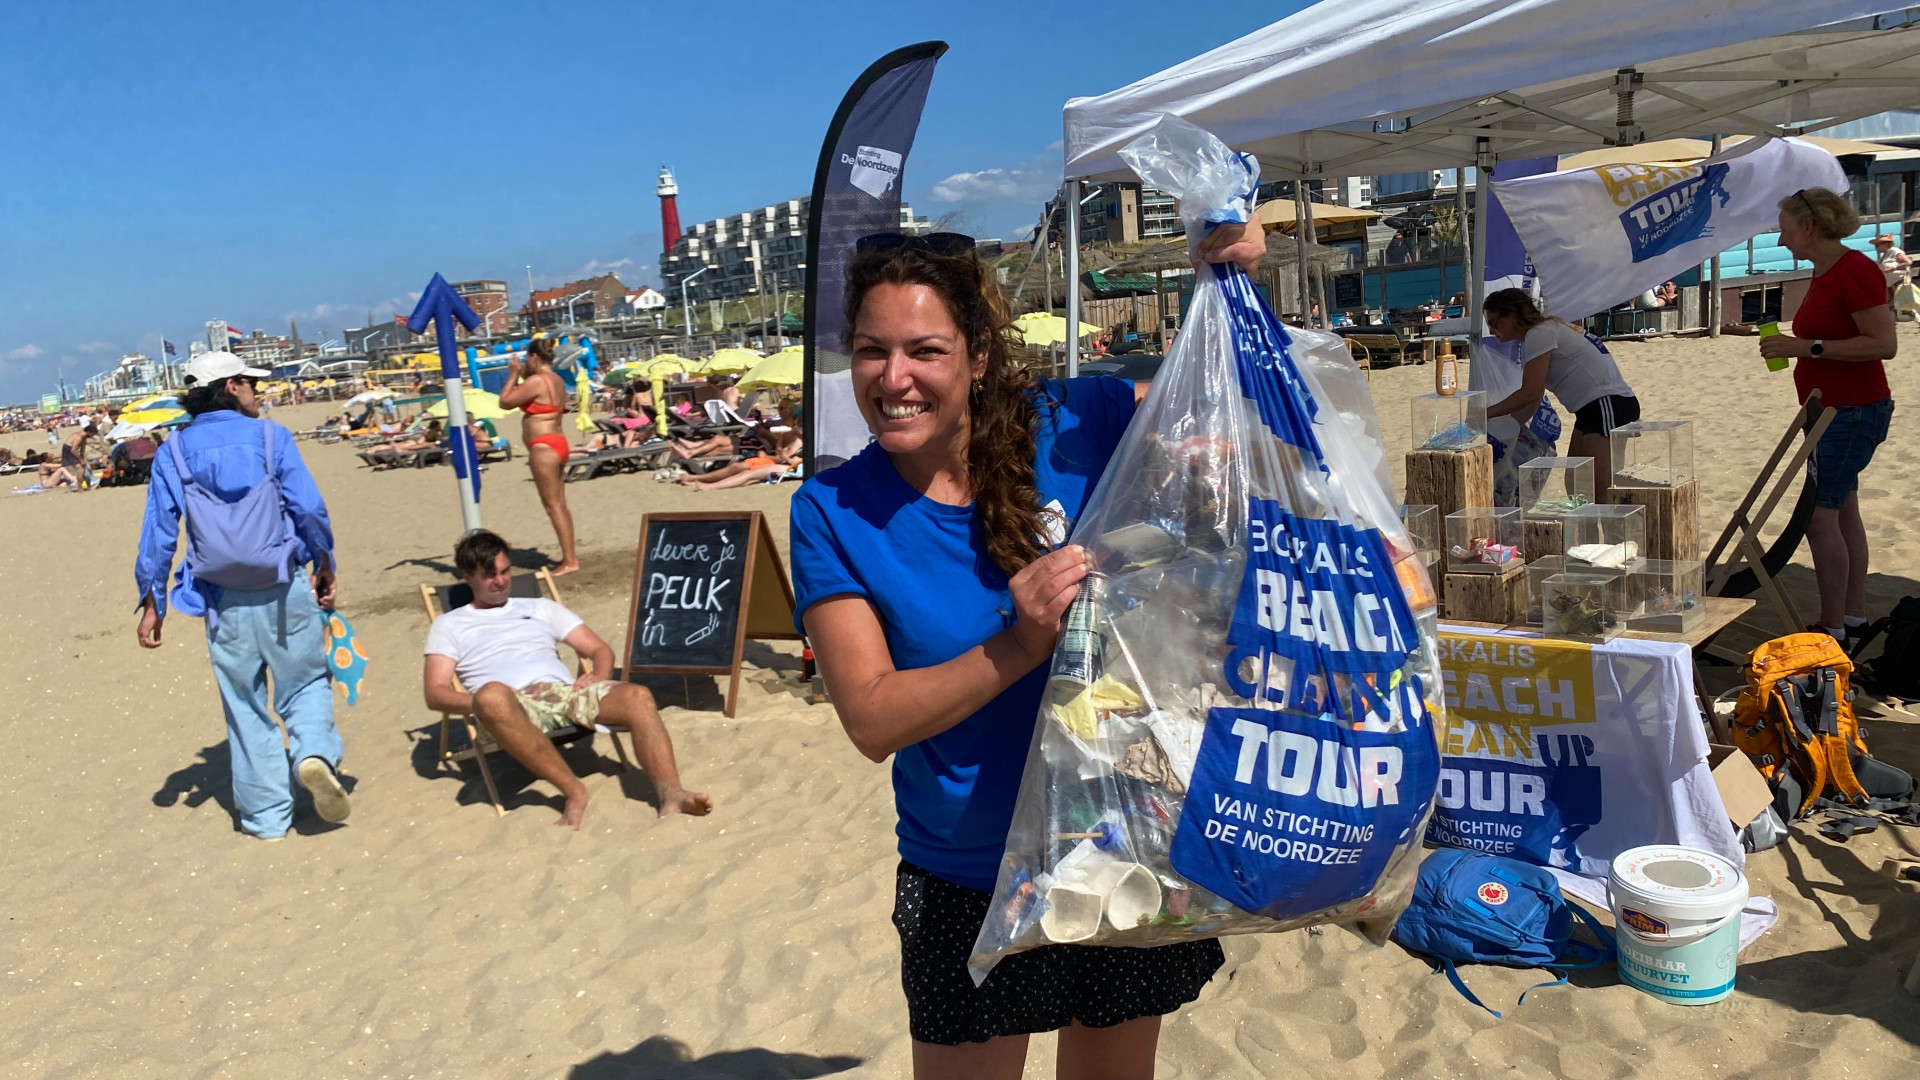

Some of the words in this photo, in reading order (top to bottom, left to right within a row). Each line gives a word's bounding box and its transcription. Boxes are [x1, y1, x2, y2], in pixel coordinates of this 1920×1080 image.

[841, 153, 855, 165] De
[855, 157, 898, 175] Noordzee
[1541, 409, 1560, 428] TO
[710, 529, 736, 574] je
[645, 573, 731, 611] PEUK
[642, 608, 667, 646] in
[1438, 637, 1536, 668] SKALIS
[1442, 669, 1576, 720] EACH
[1442, 718, 1533, 760] EAN
[1537, 734, 1595, 768] UP
[1231, 718, 1403, 809] TOUR
[1436, 768, 1546, 817] OUR
[1213, 793, 1258, 824] VAN
[1262, 806, 1374, 843] STICHTING
[1440, 815, 1523, 839] STICHTING
[1204, 819, 1240, 845] DE
[1241, 830, 1363, 865] NOORDZEE
[1434, 825, 1516, 854] NOORDZEE
[1620, 953, 1690, 984] ITUURVET
